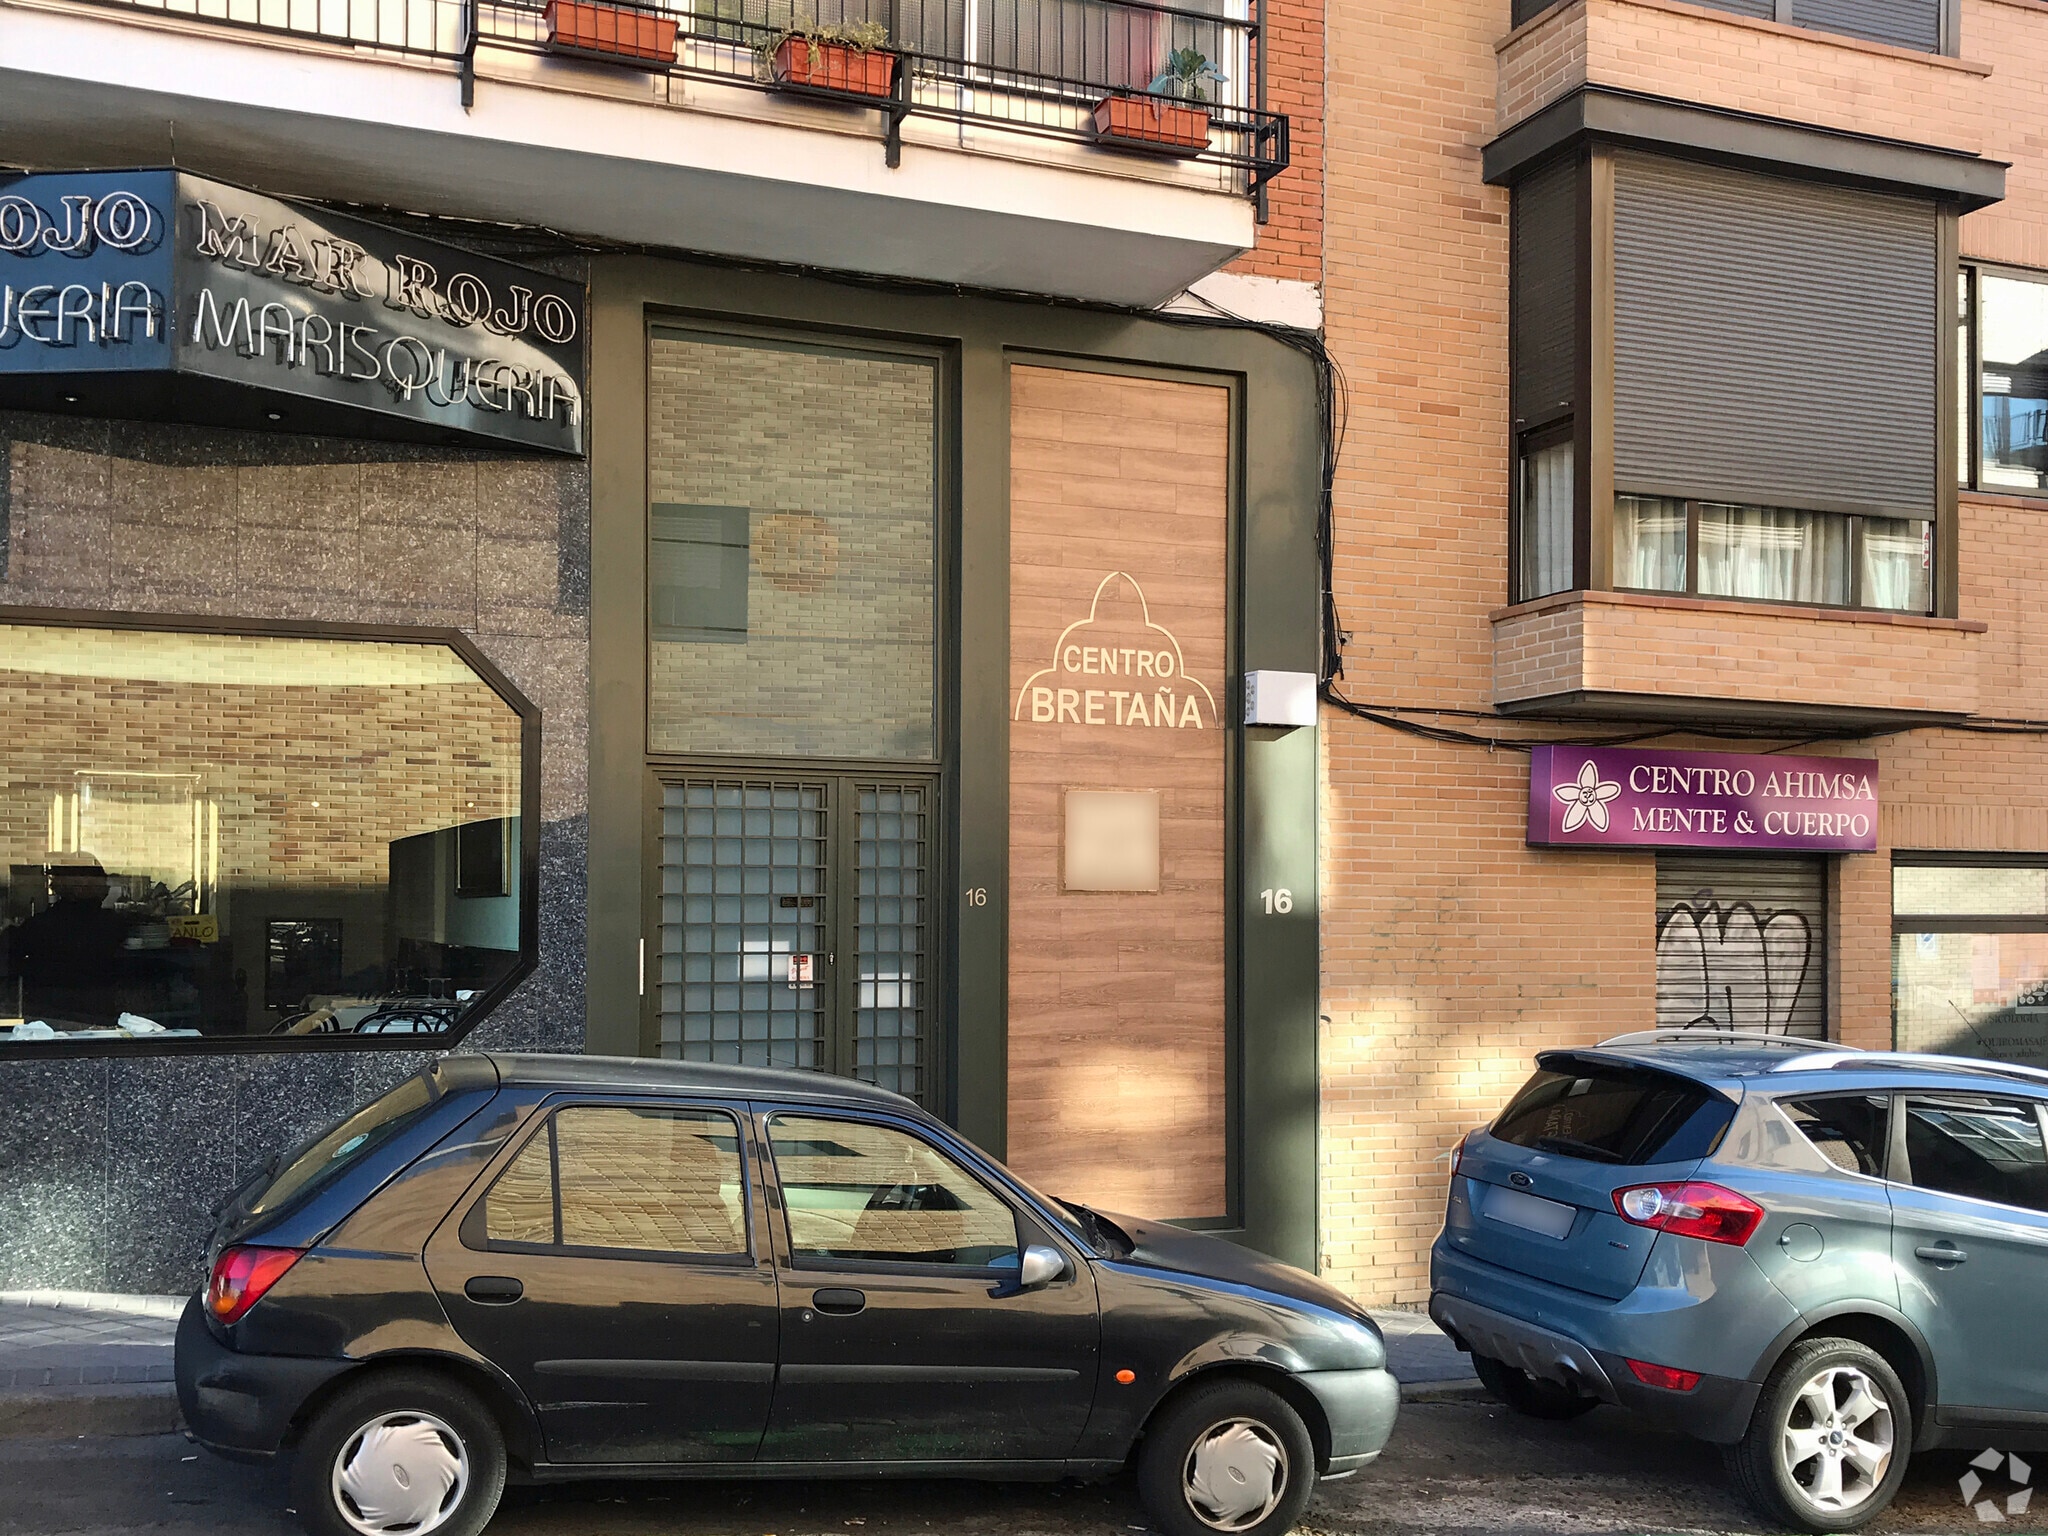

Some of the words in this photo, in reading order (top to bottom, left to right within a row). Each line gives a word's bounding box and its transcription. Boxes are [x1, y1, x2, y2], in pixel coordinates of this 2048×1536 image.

[197, 199, 375, 298] MAR
[395, 254, 577, 344] ROJO
[192, 288, 577, 427] MARISQUERIA
[1063, 644, 1175, 678] CENTRO
[1031, 686, 1204, 730] BRETAÑA
[1629, 765, 1755, 797] CENTRO
[1761, 770, 1875, 801] AHIMSA
[1631, 806, 1727, 834] MENTE
[1733, 810, 1758, 835] &
[1764, 810, 1870, 838] CUERPO
[964, 887, 987, 907] 16
[1260, 888, 1293, 915] 16
